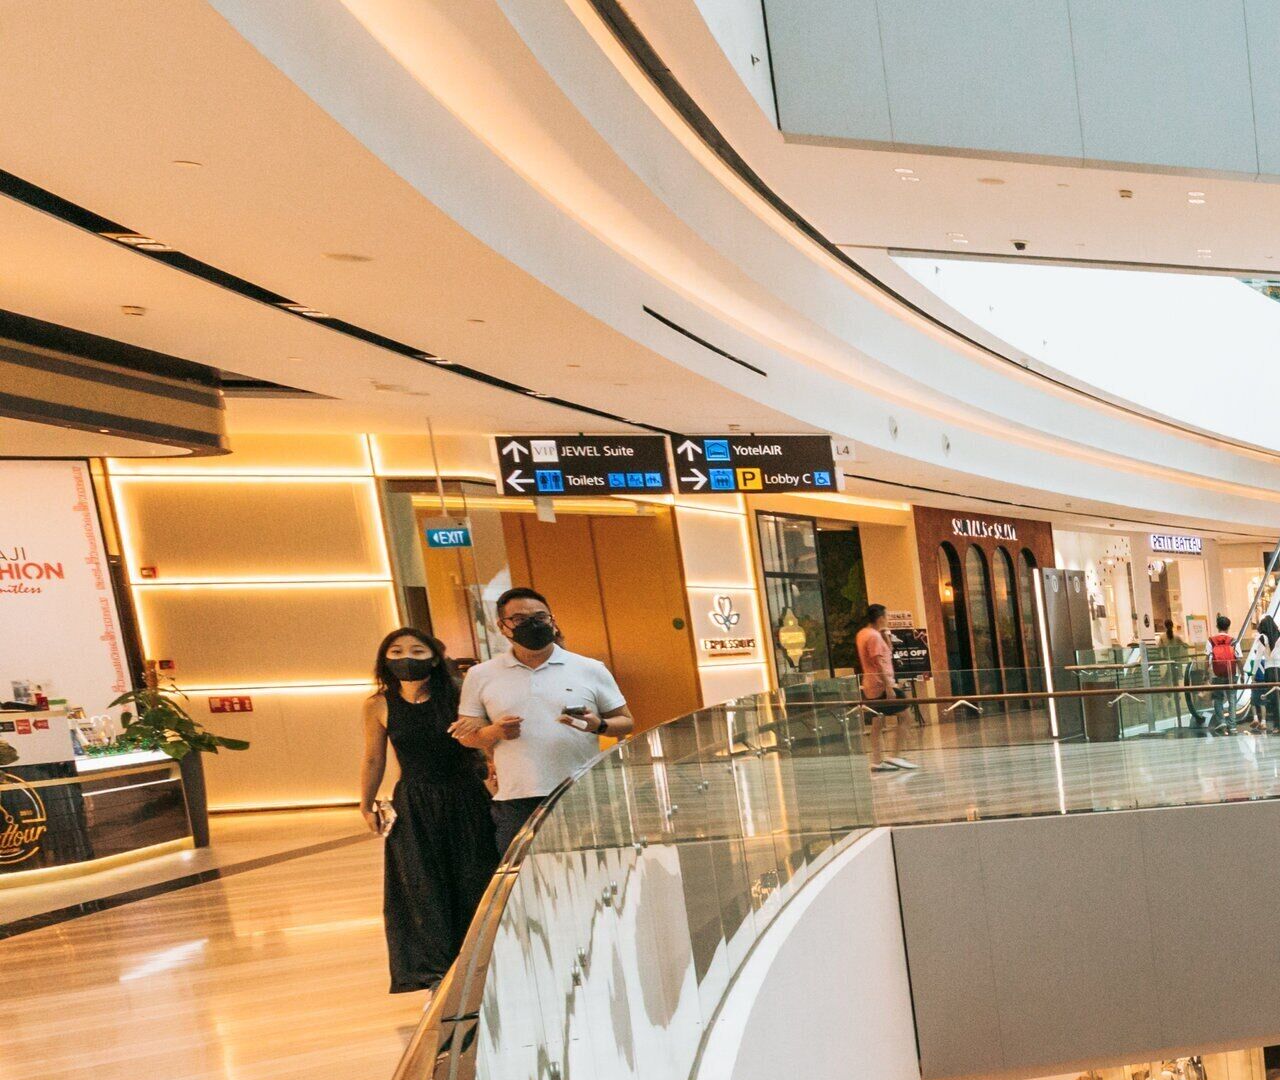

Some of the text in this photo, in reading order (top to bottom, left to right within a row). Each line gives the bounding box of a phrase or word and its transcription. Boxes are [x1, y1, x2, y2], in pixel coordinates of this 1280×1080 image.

[533, 445, 634, 457] VIP JEWEL Suite
[732, 444, 783, 456] YotelAIR
[836, 445, 850, 455] L4
[566, 475, 605, 486] Toilets
[742, 471, 812, 487] P Lobby C
[438, 530, 465, 545] EXIT
[909, 649, 927, 657] OFF
